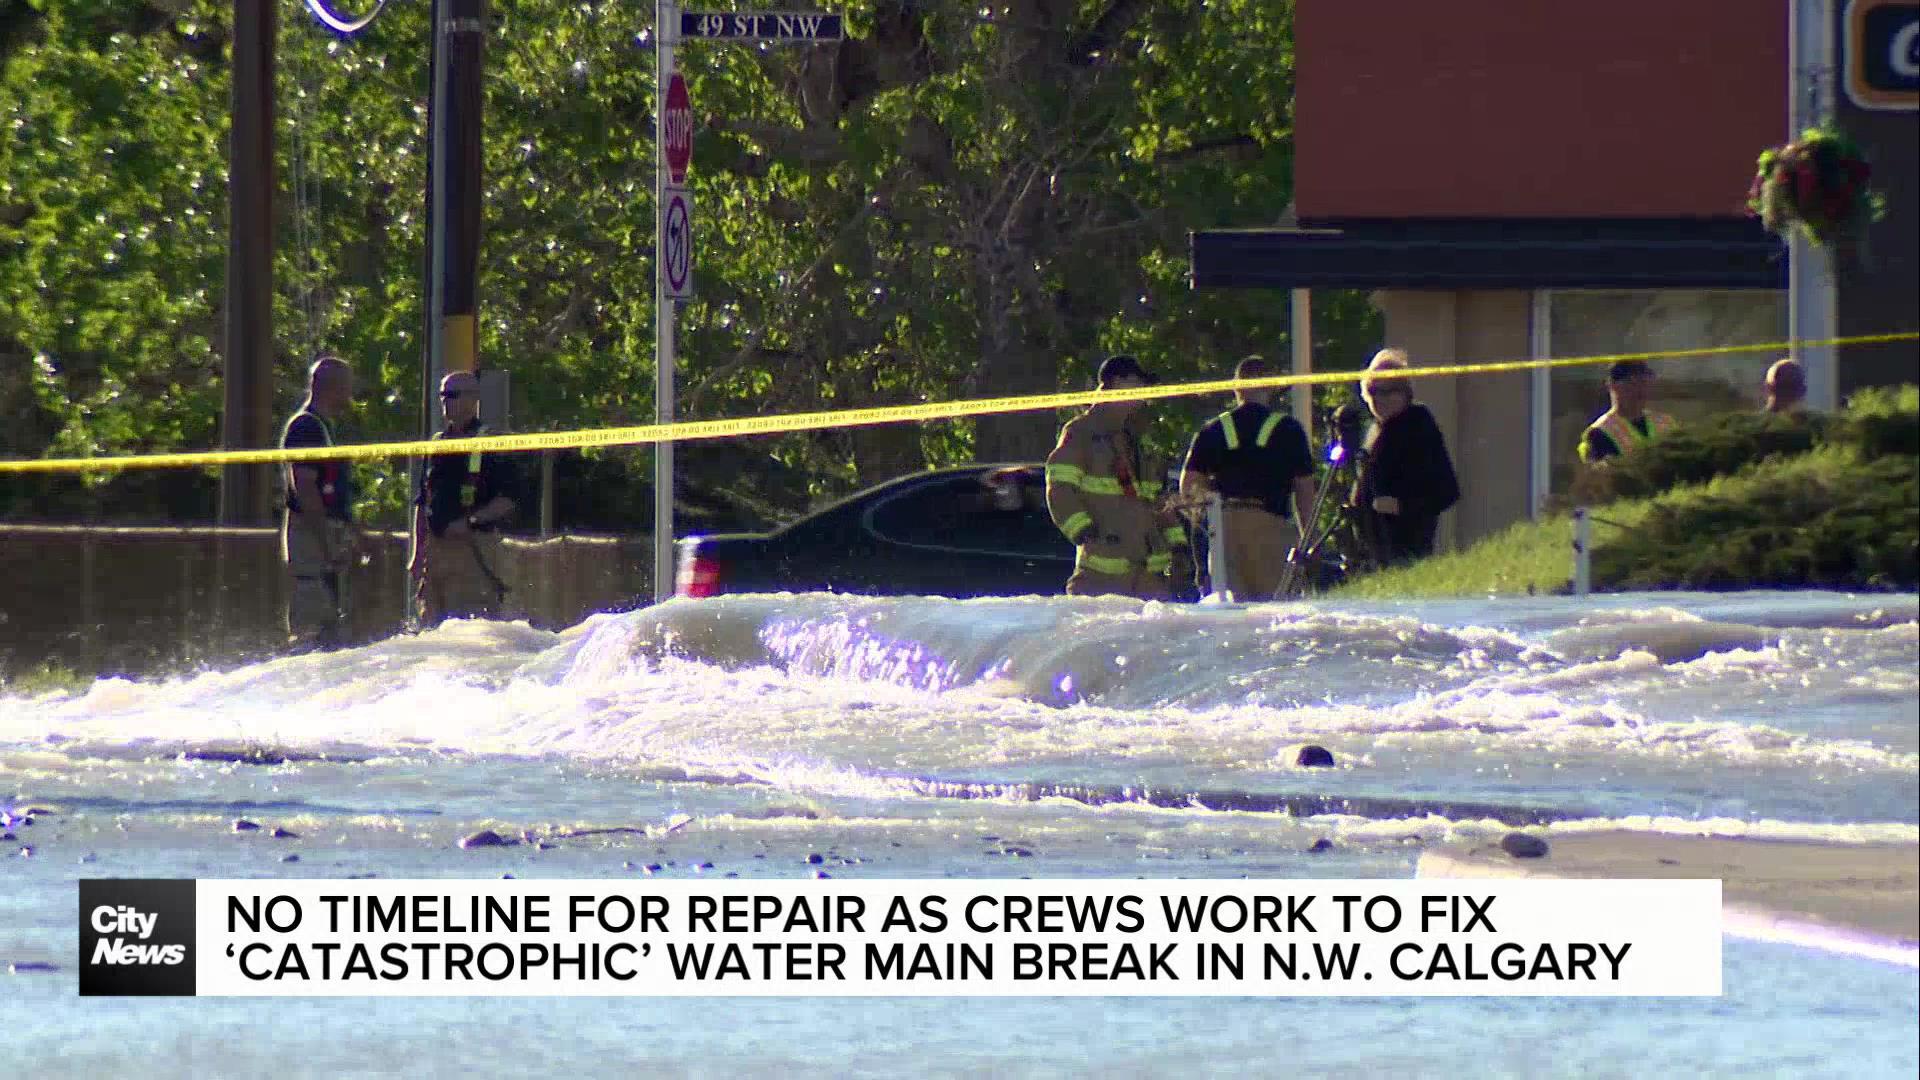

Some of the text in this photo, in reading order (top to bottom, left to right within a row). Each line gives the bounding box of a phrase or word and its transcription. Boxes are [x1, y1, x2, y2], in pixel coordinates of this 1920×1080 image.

[697, 15, 823, 39] 49 ST NW
[666, 109, 690, 149] STOP
